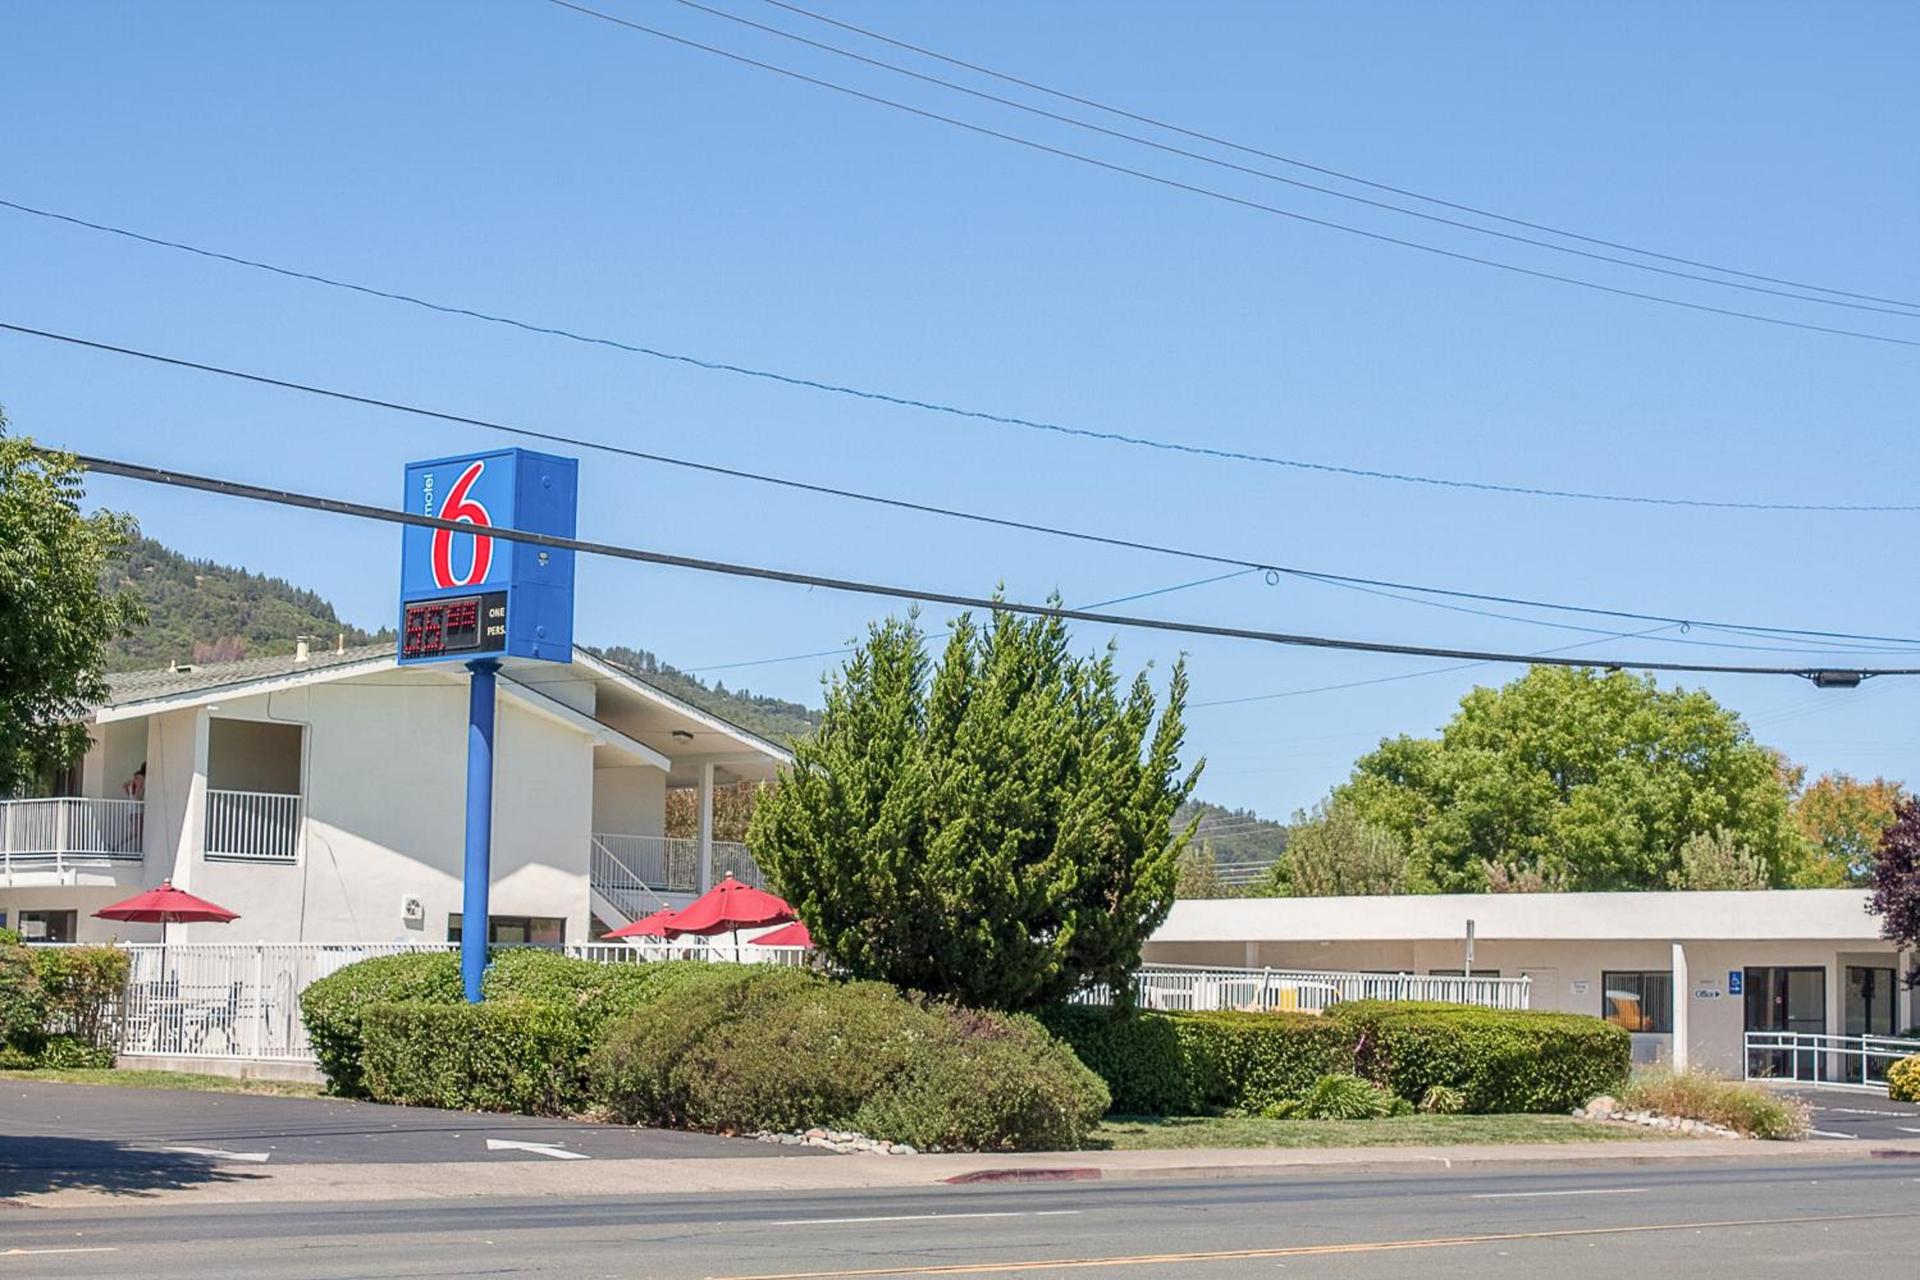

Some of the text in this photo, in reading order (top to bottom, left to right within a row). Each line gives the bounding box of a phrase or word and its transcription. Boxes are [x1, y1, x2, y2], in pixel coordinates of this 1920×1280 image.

[423, 473, 433, 517] motel
[432, 460, 494, 589] 6
[488, 607, 505, 618] ONE
[1696, 990, 1714, 999] Office
